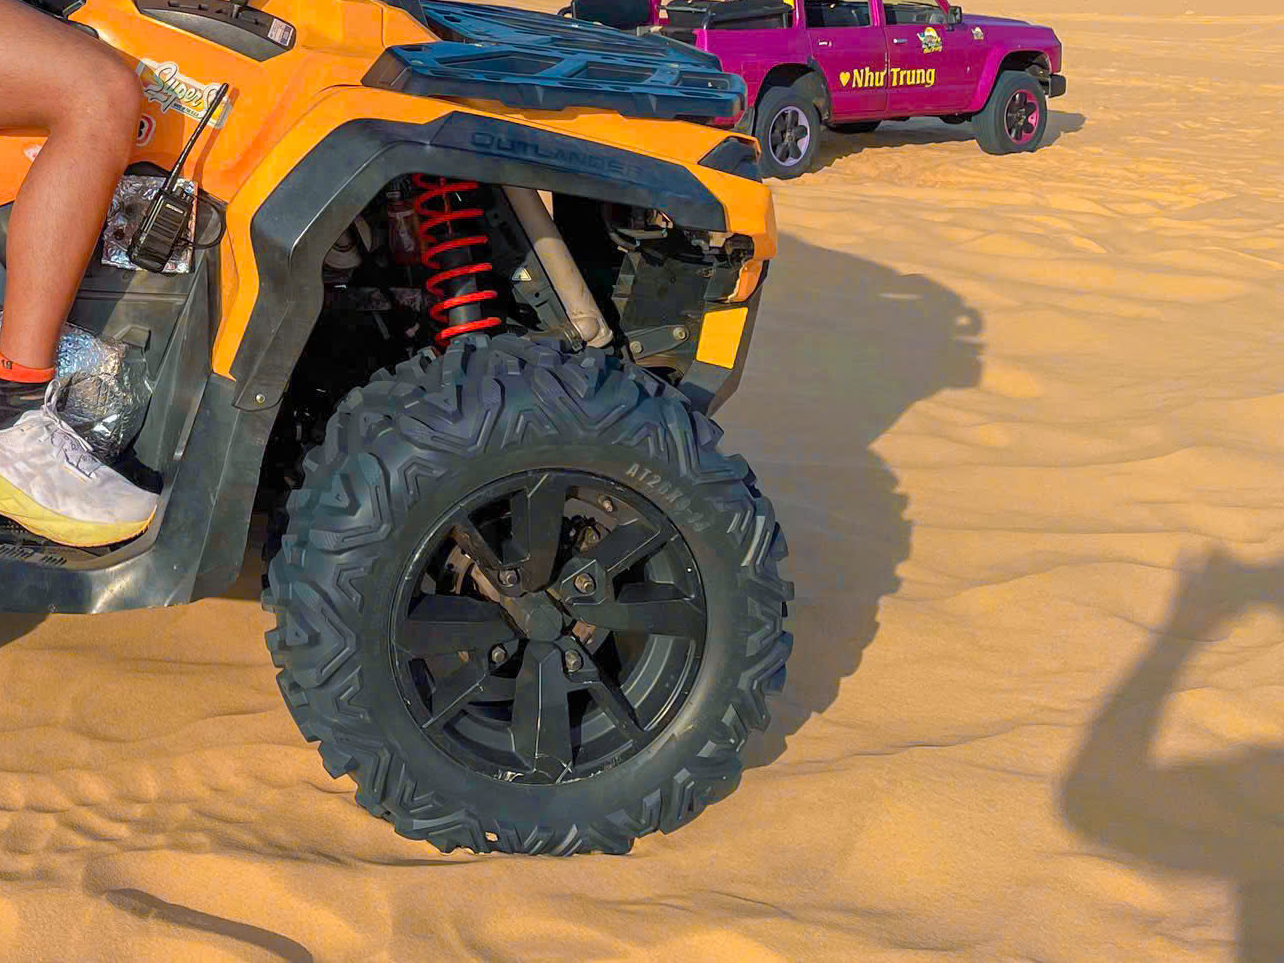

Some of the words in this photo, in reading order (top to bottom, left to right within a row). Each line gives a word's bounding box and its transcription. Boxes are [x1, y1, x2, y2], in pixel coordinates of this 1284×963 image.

[852, 66, 886, 87] Như
[890, 67, 935, 87] Trung
[471, 131, 644, 177] OUTLANDER
